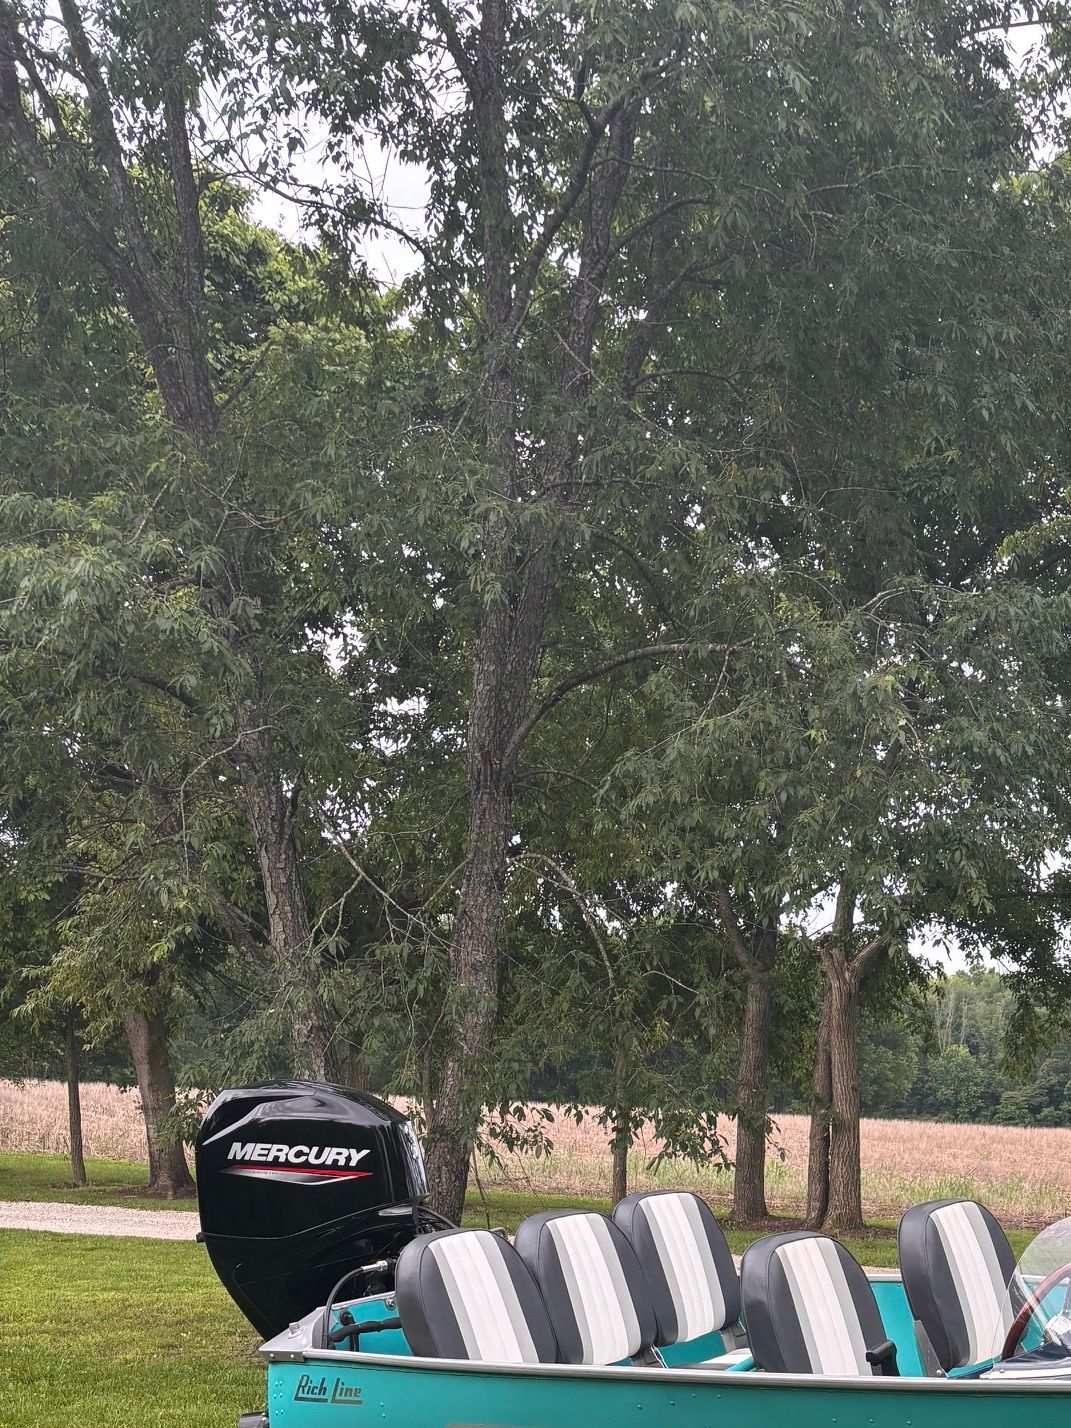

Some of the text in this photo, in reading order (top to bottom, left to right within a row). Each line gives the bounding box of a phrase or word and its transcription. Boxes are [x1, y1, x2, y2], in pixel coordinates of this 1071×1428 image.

[227, 1142, 370, 1166] MERCURY
[294, 1374, 363, 1405] Rich Line
